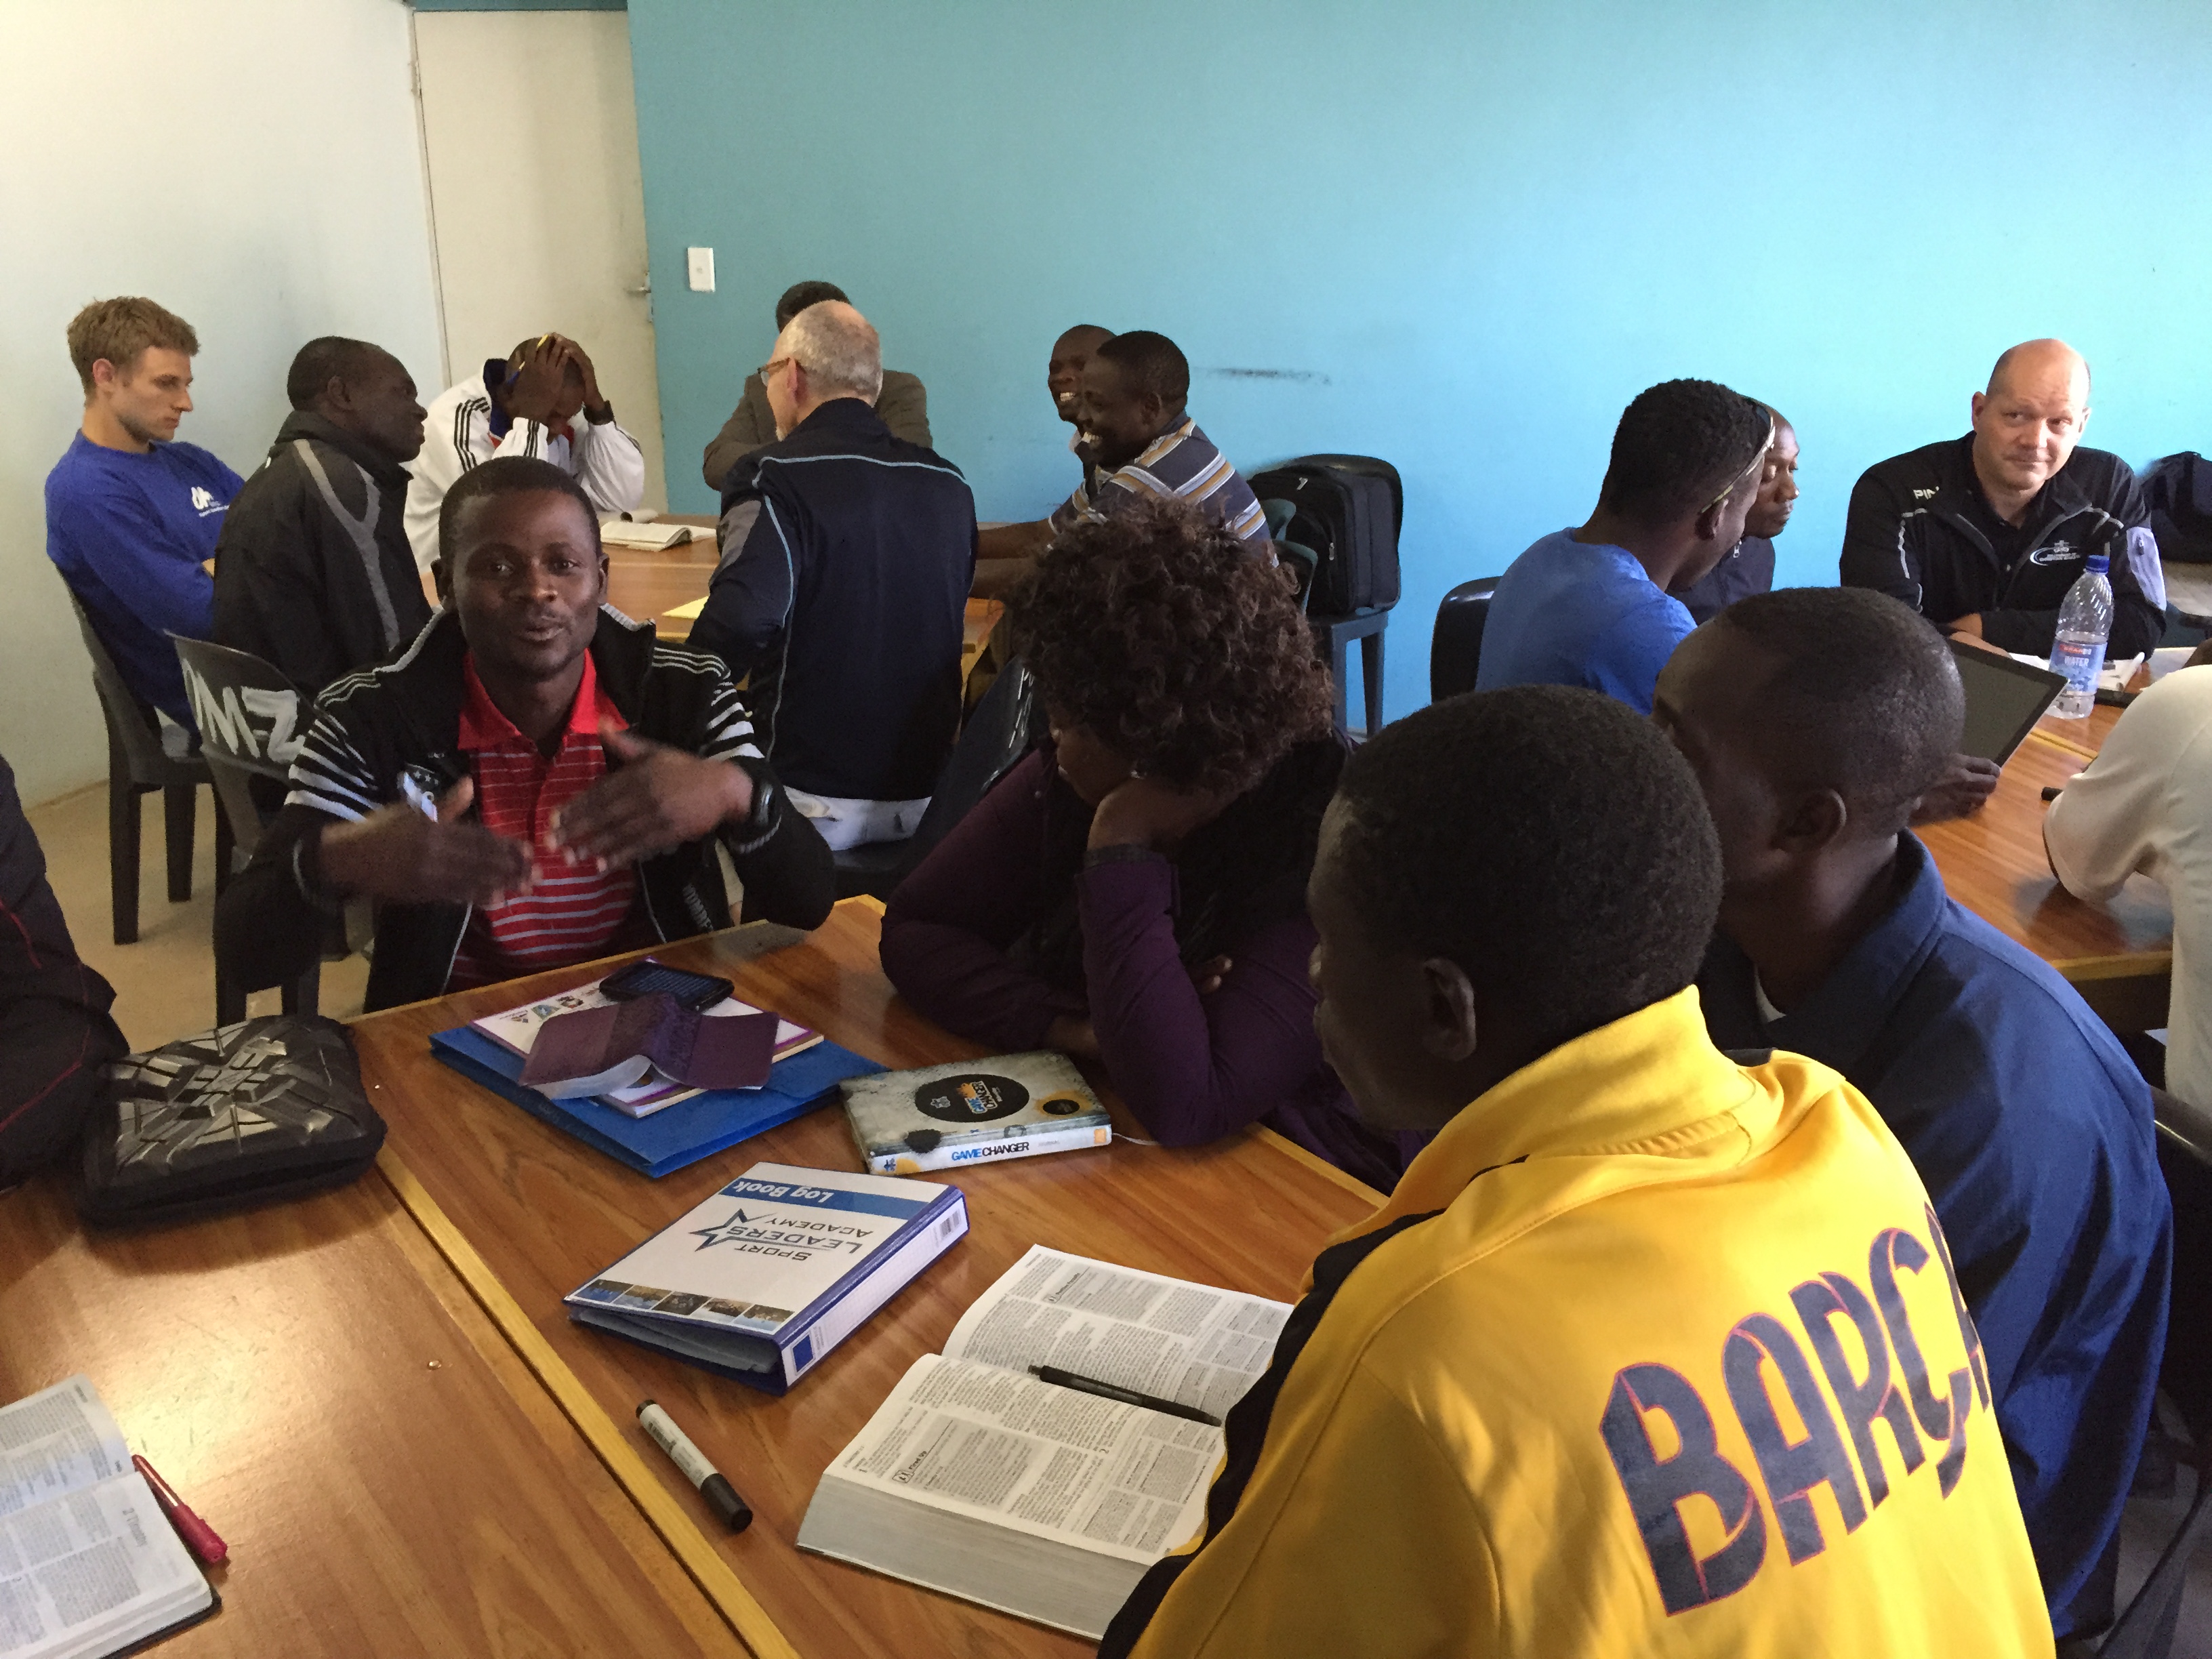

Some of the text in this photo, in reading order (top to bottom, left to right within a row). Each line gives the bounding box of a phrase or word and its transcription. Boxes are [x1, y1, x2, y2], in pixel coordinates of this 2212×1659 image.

[733, 1180, 834, 1203] Log Book
[763, 1217, 874, 1238] ACADEMY
[725, 1225, 863, 1254] LEADERS
[734, 1243, 813, 1261] SPORT
